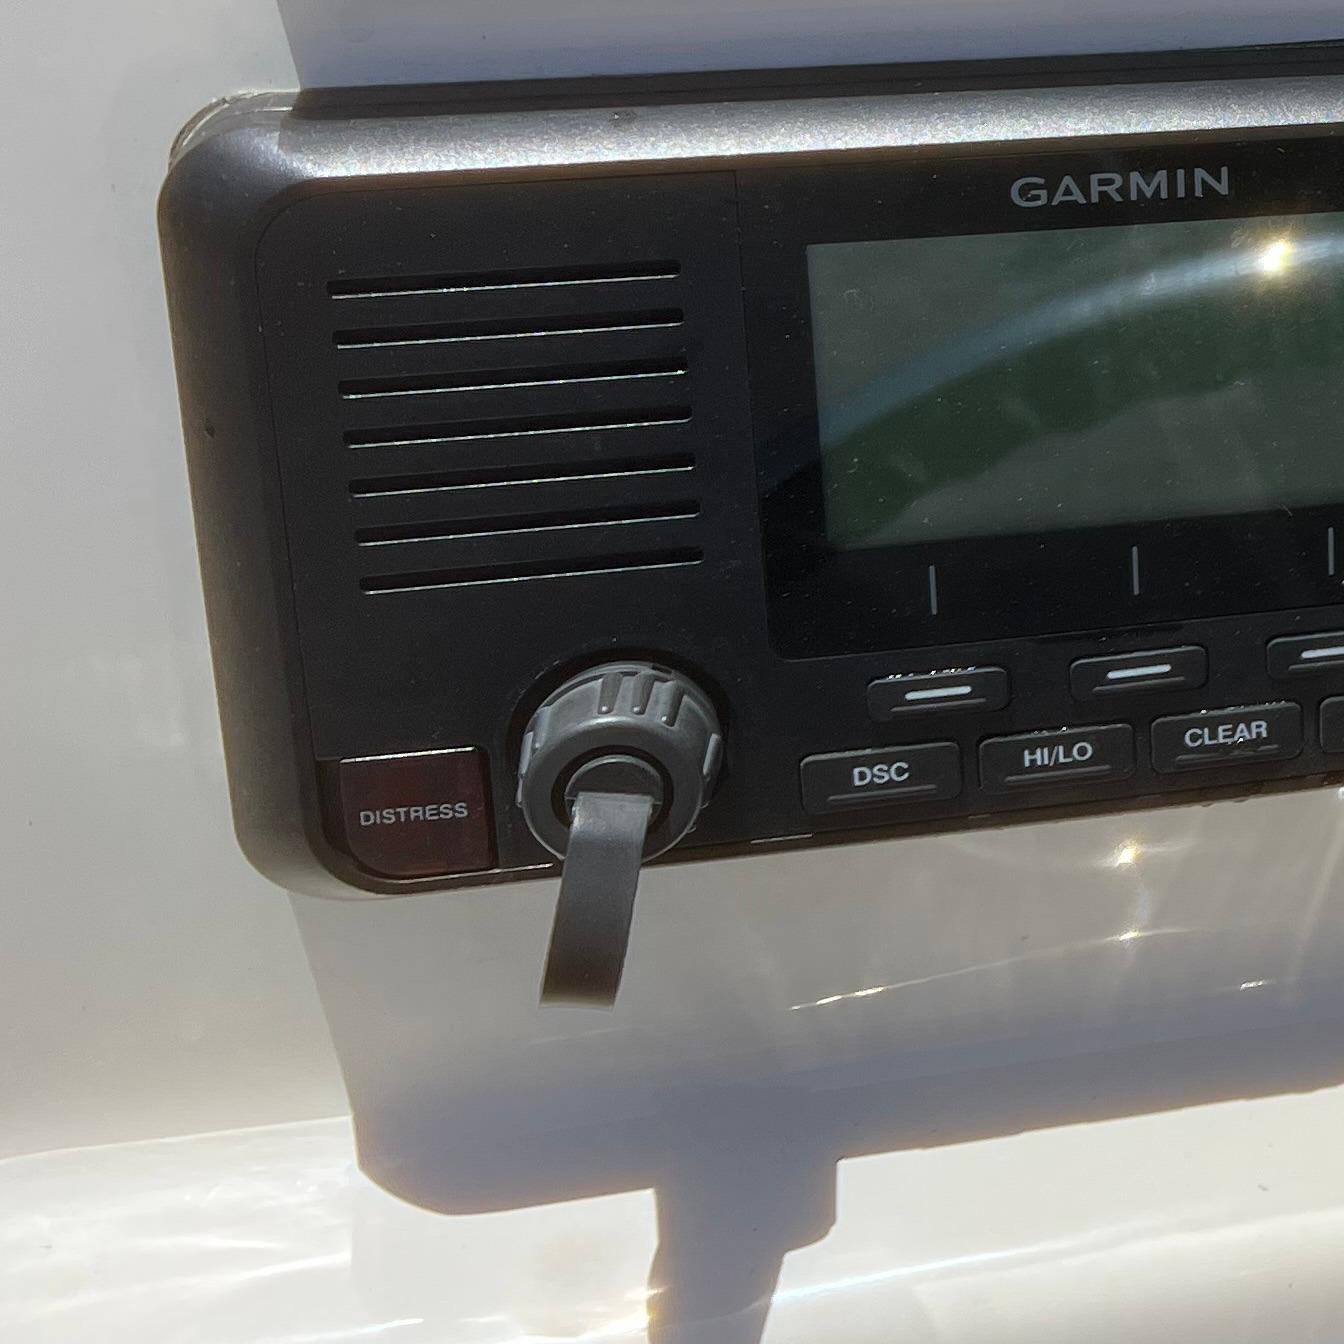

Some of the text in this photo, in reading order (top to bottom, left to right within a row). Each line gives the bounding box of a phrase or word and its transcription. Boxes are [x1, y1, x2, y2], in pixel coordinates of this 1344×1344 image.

[1010, 165, 1229, 207] GARMIN
[1184, 719, 1268, 748] CLEAR
[1023, 741, 1094, 767] HI/LO
[852, 762, 910, 787] DSC
[359, 802, 469, 827] DISTRESS
